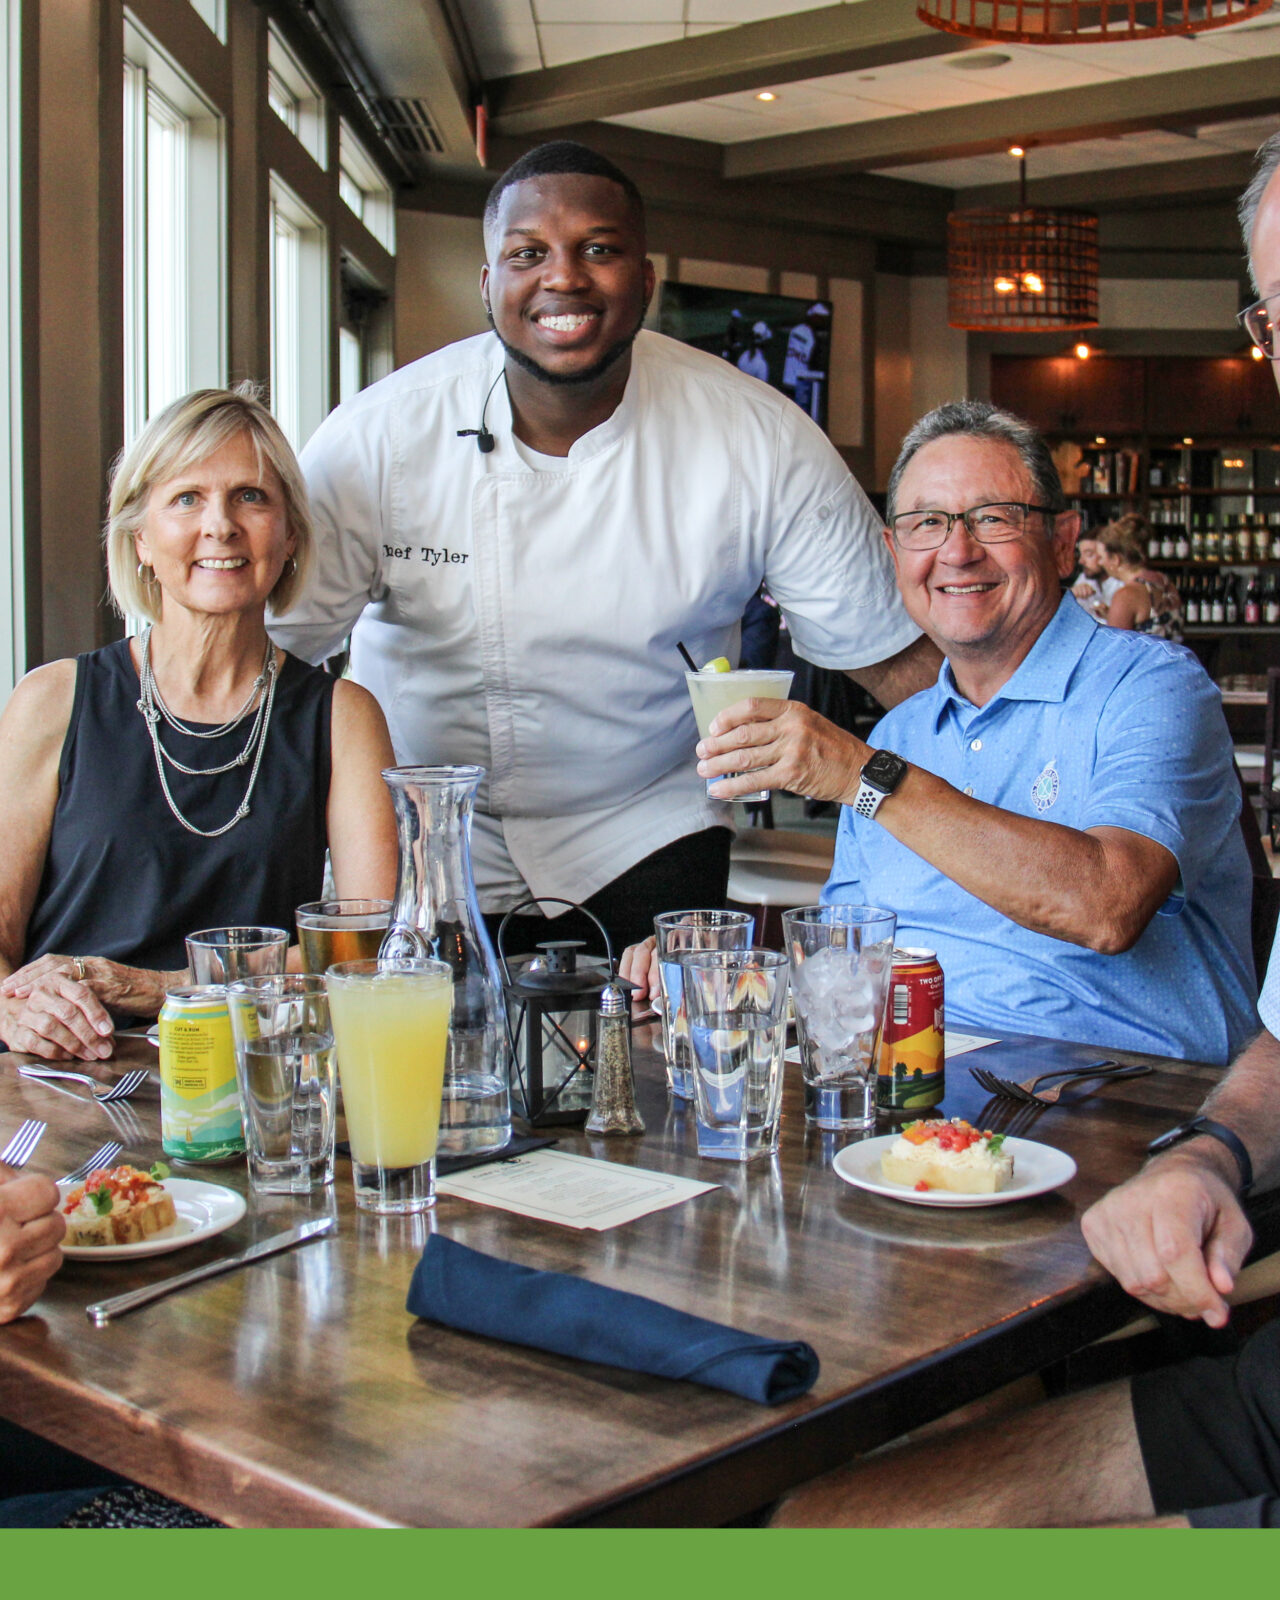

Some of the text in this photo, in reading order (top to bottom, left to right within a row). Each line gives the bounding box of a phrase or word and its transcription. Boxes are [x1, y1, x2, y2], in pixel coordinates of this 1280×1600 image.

[383, 544, 469, 567] hef Tyler
[919, 977, 933, 985] TWO
